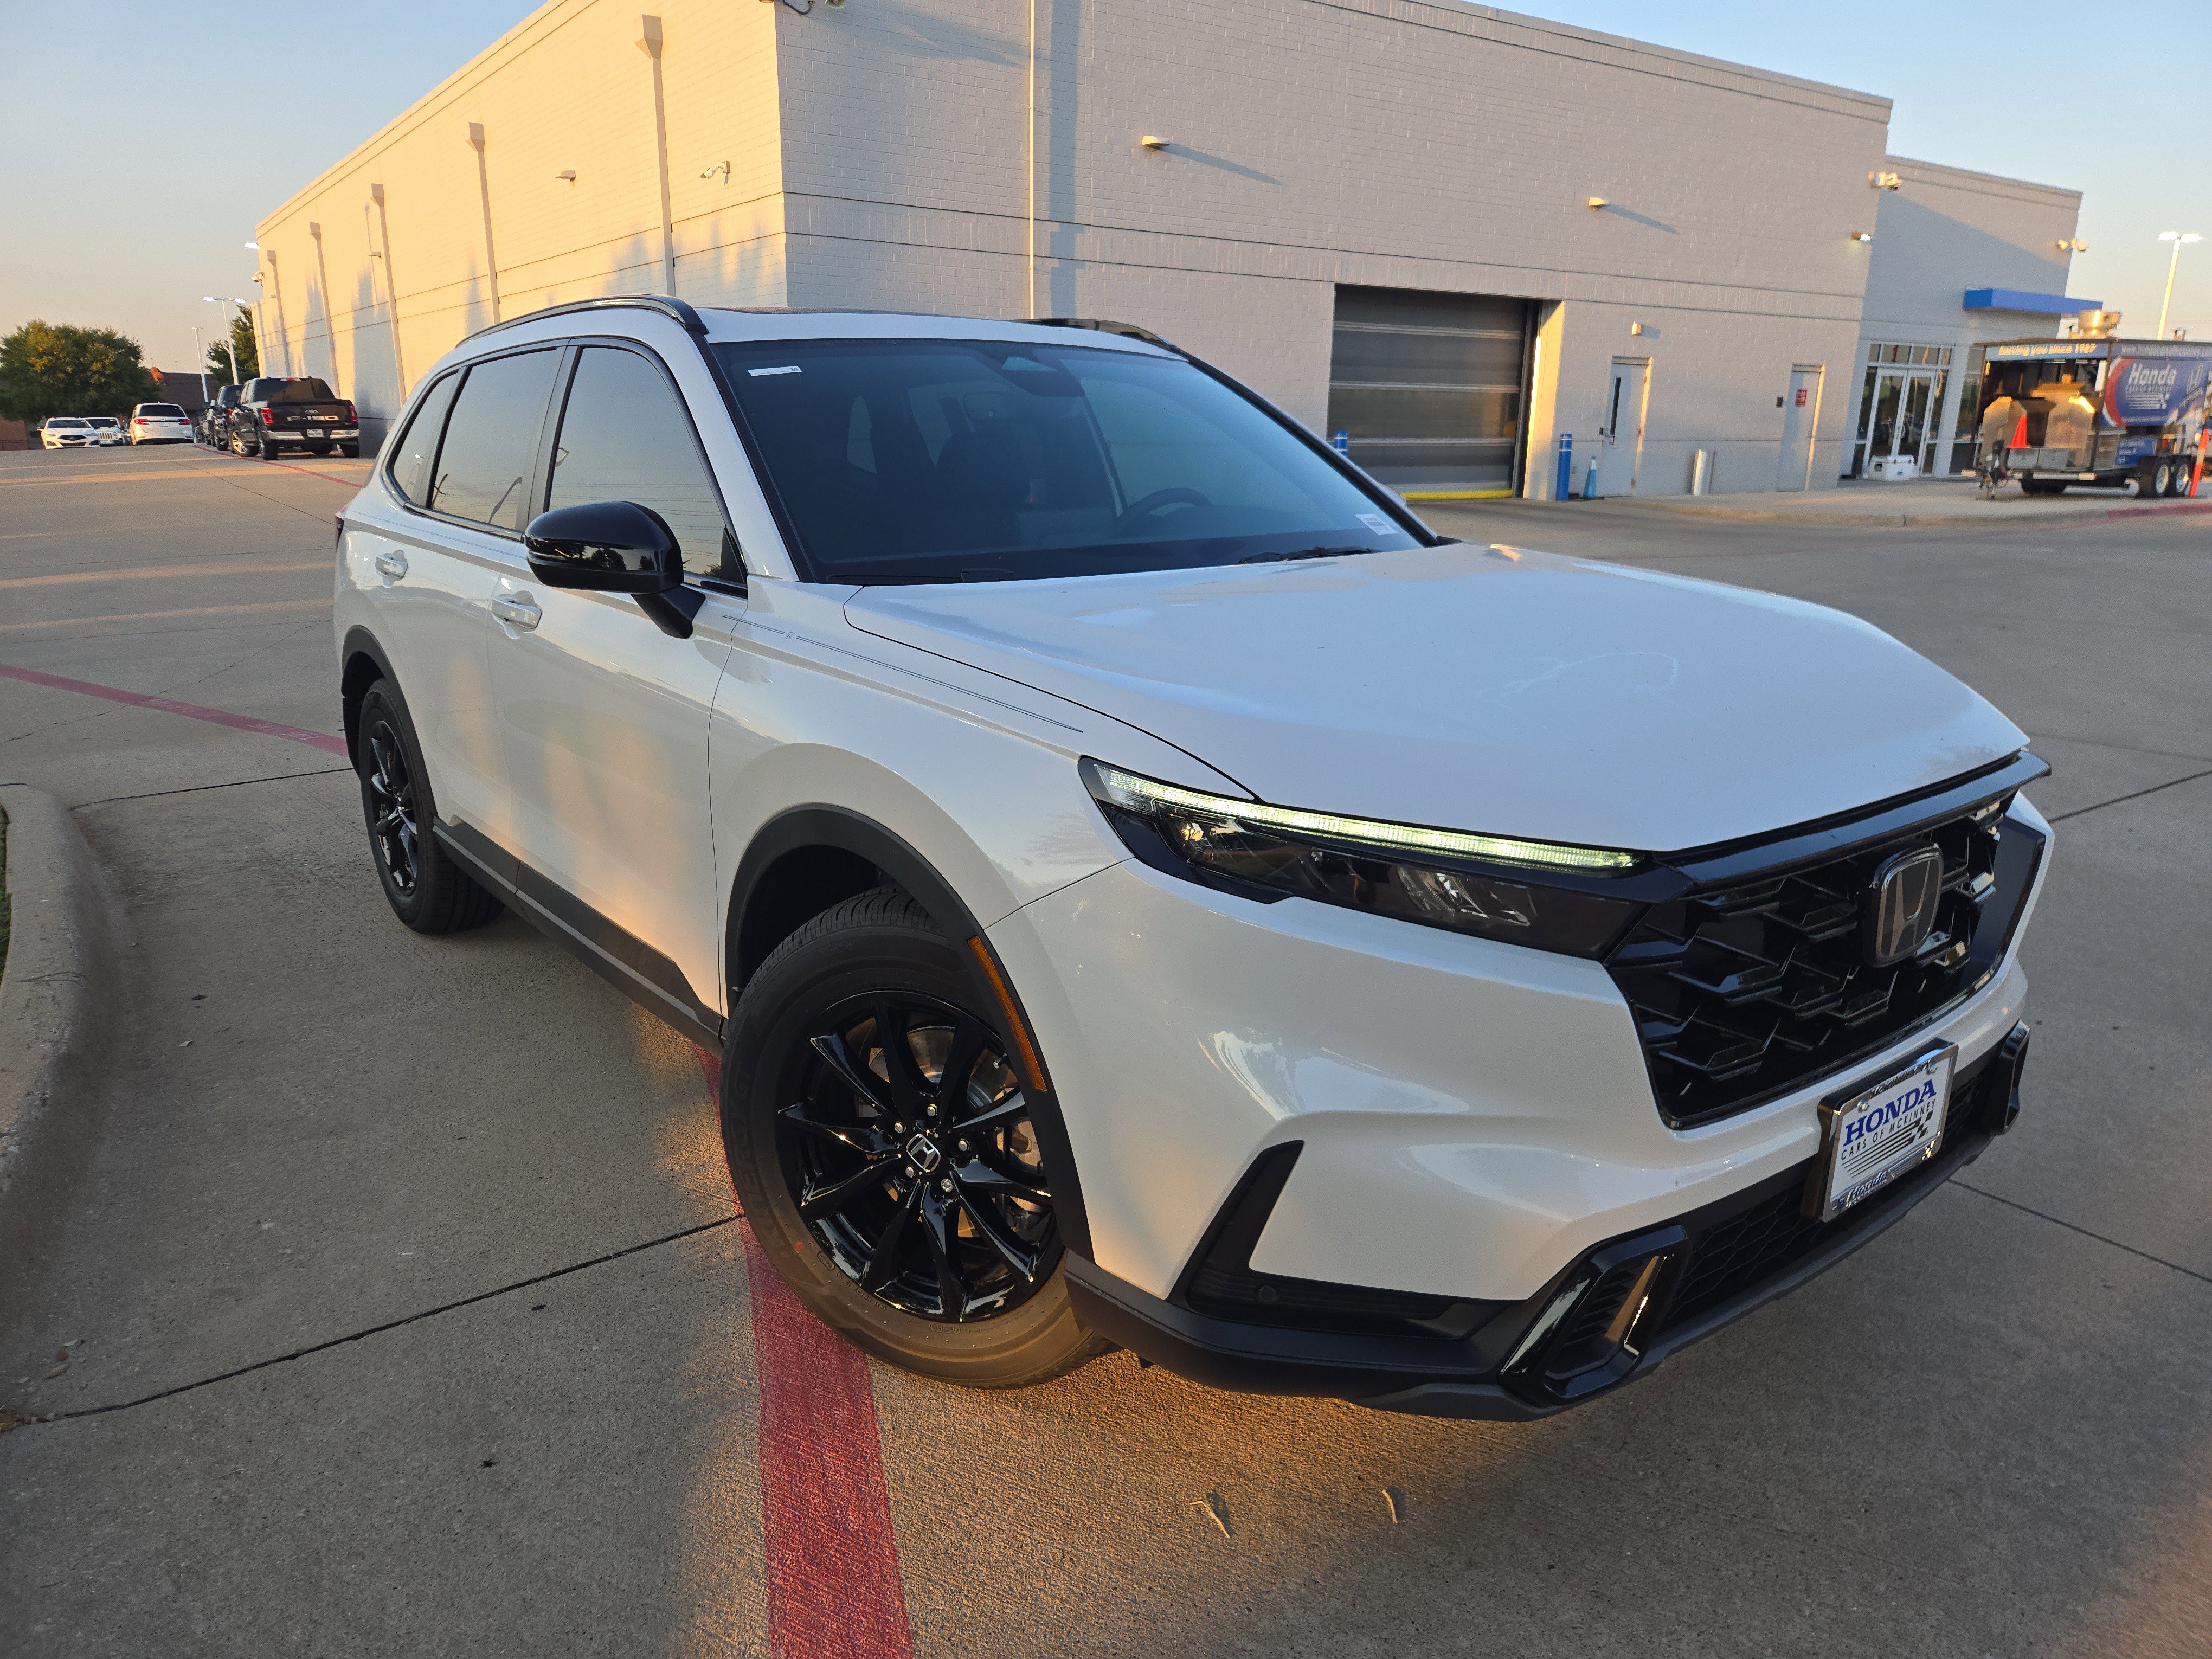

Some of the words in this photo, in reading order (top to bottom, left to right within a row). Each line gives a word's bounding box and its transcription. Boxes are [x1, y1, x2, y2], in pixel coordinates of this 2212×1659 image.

[2128, 363, 2177, 385] Honda
[1841, 1138, 1867, 1160] CARS
[1872, 1128, 1884, 1143] OF
[1888, 1098, 1936, 1134] MCKINNEY
[1843, 1078, 1937, 1147] HONDA
